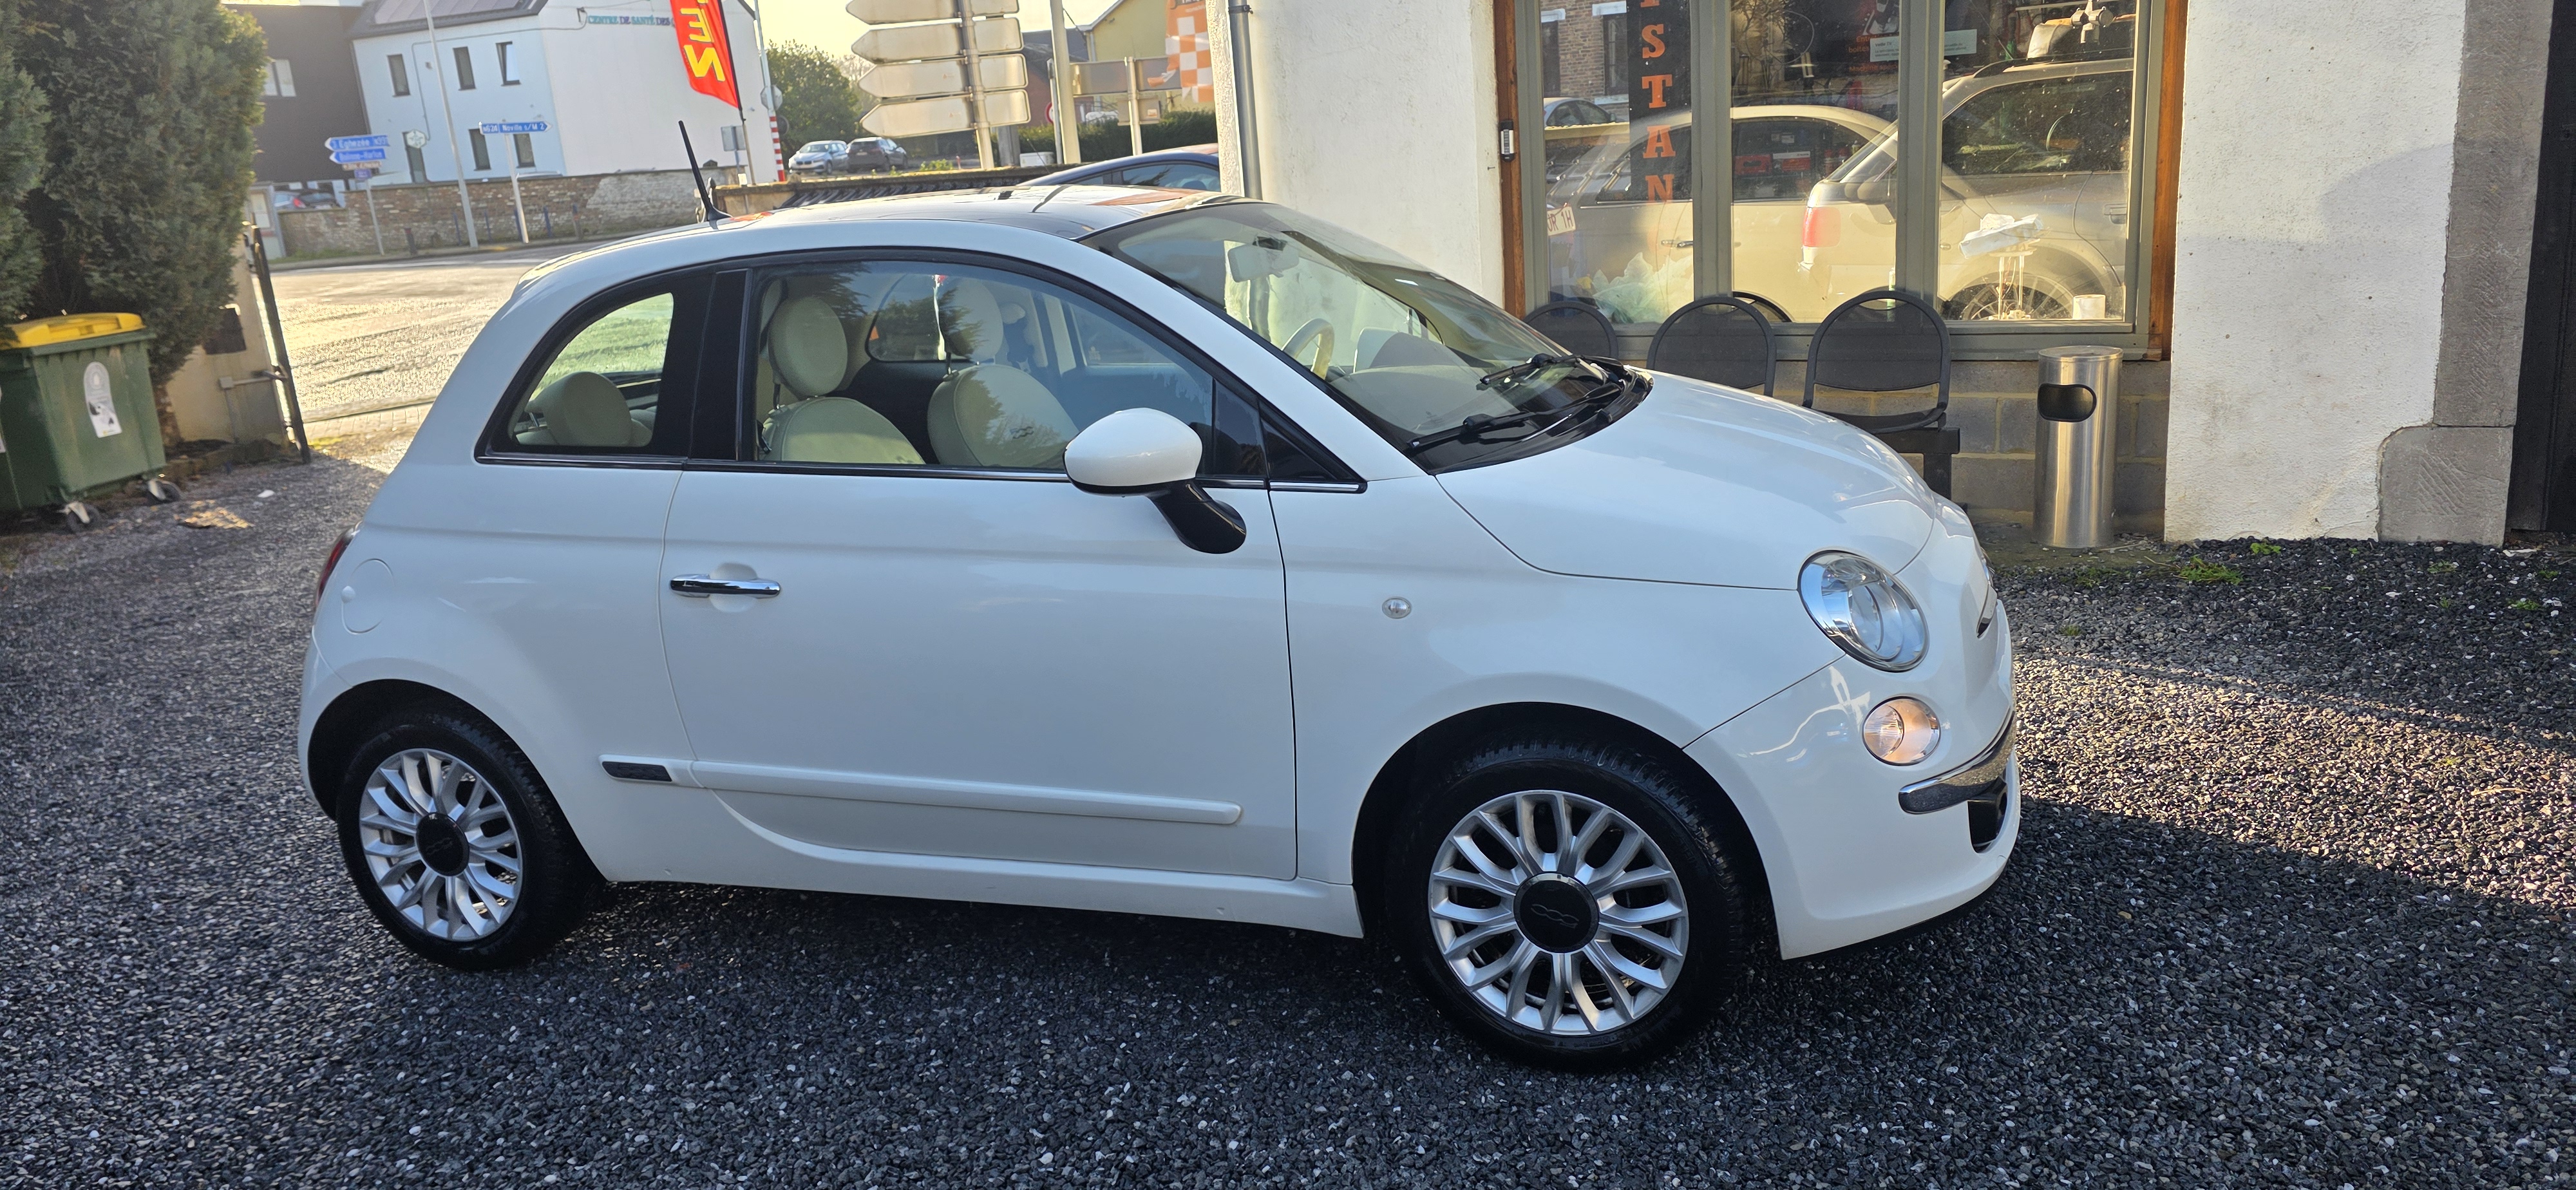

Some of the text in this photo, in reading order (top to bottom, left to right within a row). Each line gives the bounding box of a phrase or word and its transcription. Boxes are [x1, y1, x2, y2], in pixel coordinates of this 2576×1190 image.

[588, 15, 618, 24] CENTRE
[620, 16, 630, 24] DE
[631, 14, 656, 25] SANTÉ
[656, 17, 670, 26] DES
[1641, 0, 1676, 256] STAN
